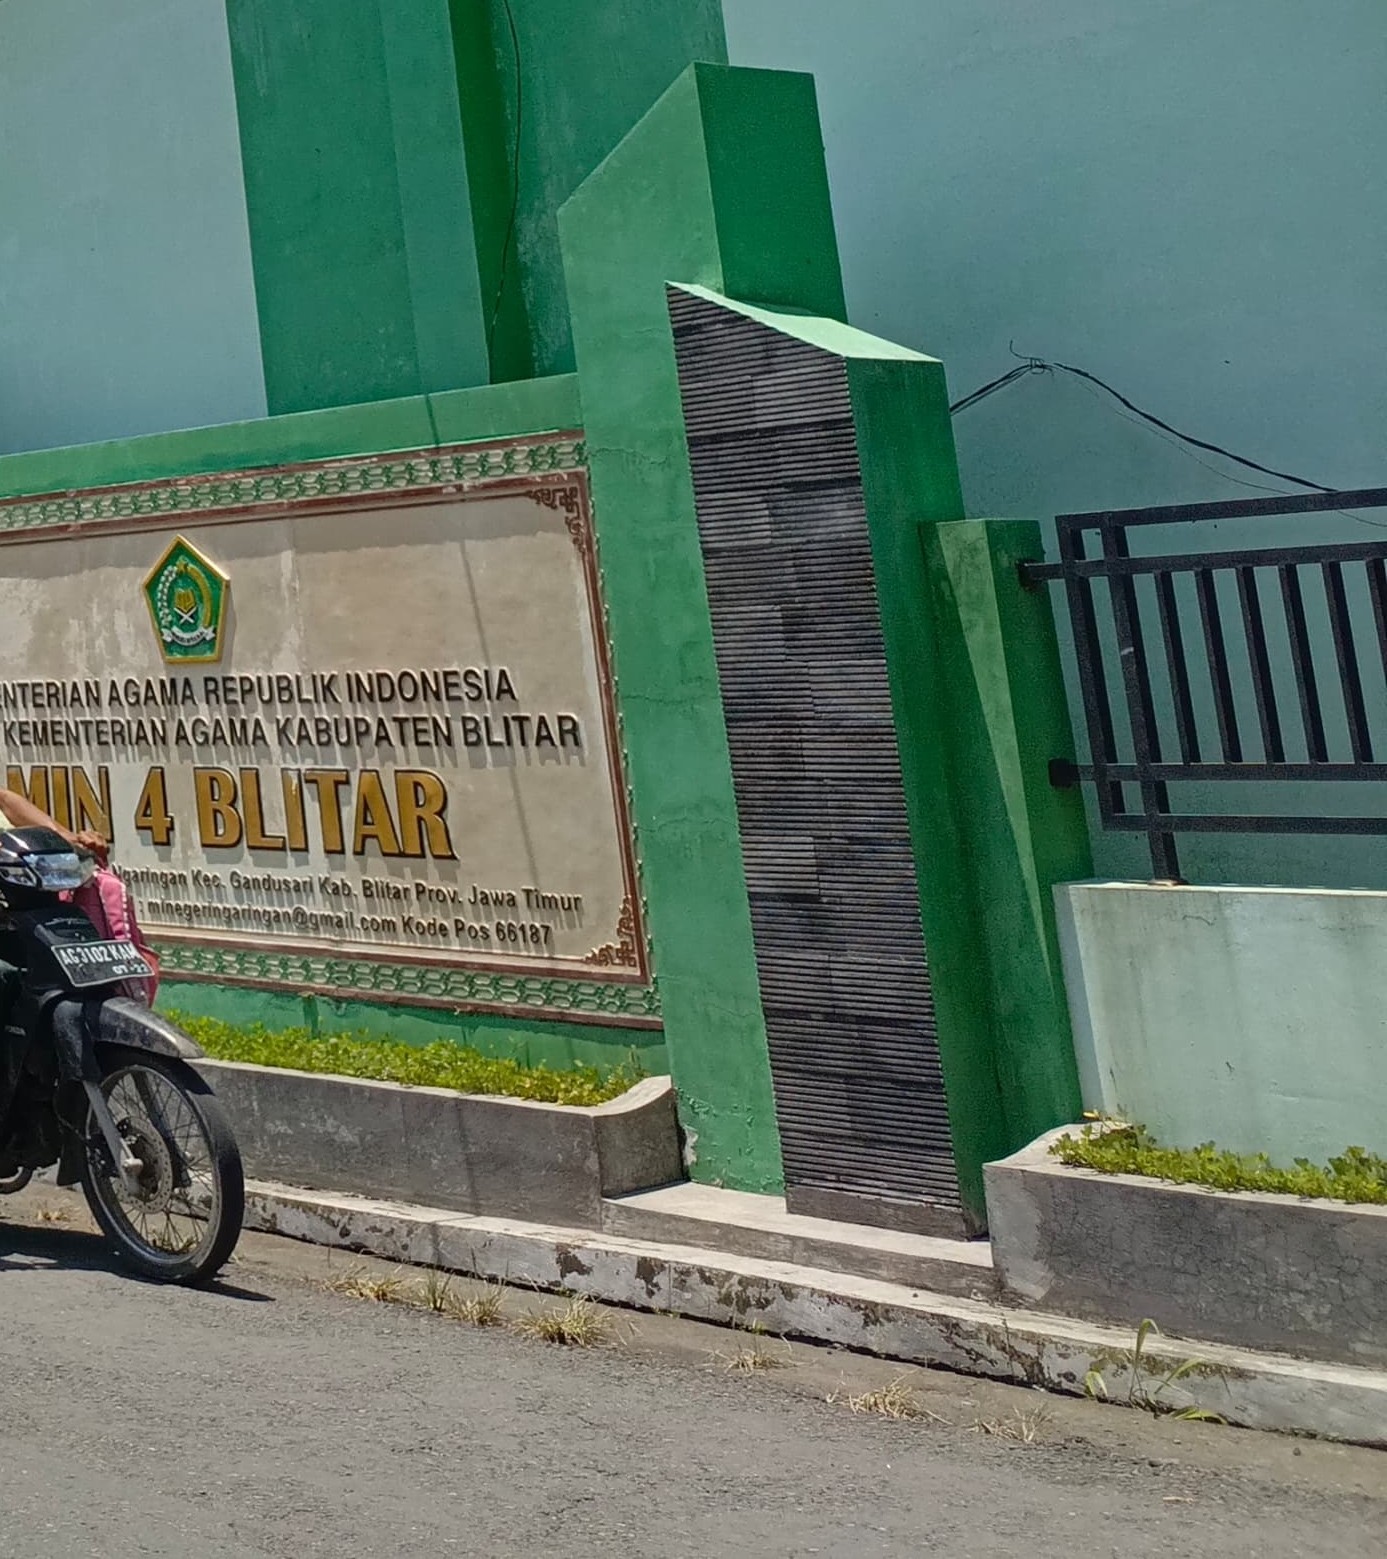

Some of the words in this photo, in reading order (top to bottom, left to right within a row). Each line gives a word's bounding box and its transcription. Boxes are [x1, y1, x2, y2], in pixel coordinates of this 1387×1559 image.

[107, 676, 198, 708] AGAMA
[203, 672, 341, 705] REPUBLIK
[345, 668, 517, 704] INDONESIA
[3, 719, 167, 747] KEMENTERIAN
[174, 716, 269, 747] AGAMA
[275, 715, 453, 748] KABUPATEN
[461, 714, 582, 748] BLITAR
[6, 765, 114, 843] MIN
[135, 766, 173, 846] 4
[193, 766, 461, 861] BLITAR
[191, 869, 226, 890] Kec.
[229, 870, 314, 894] Gandusari
[318, 876, 357, 898] Kab.
[361, 878, 410, 901] Blitar
[414, 882, 463, 905] Prov.
[468, 885, 517, 907] Jawa
[521, 888, 583, 912] Timur
[147, 898, 397, 933] minegeringaringan@gmail.com
[401, 916, 449, 938] Kode
[453, 918, 491, 941] Pos
[495, 921, 553, 945] 66187
